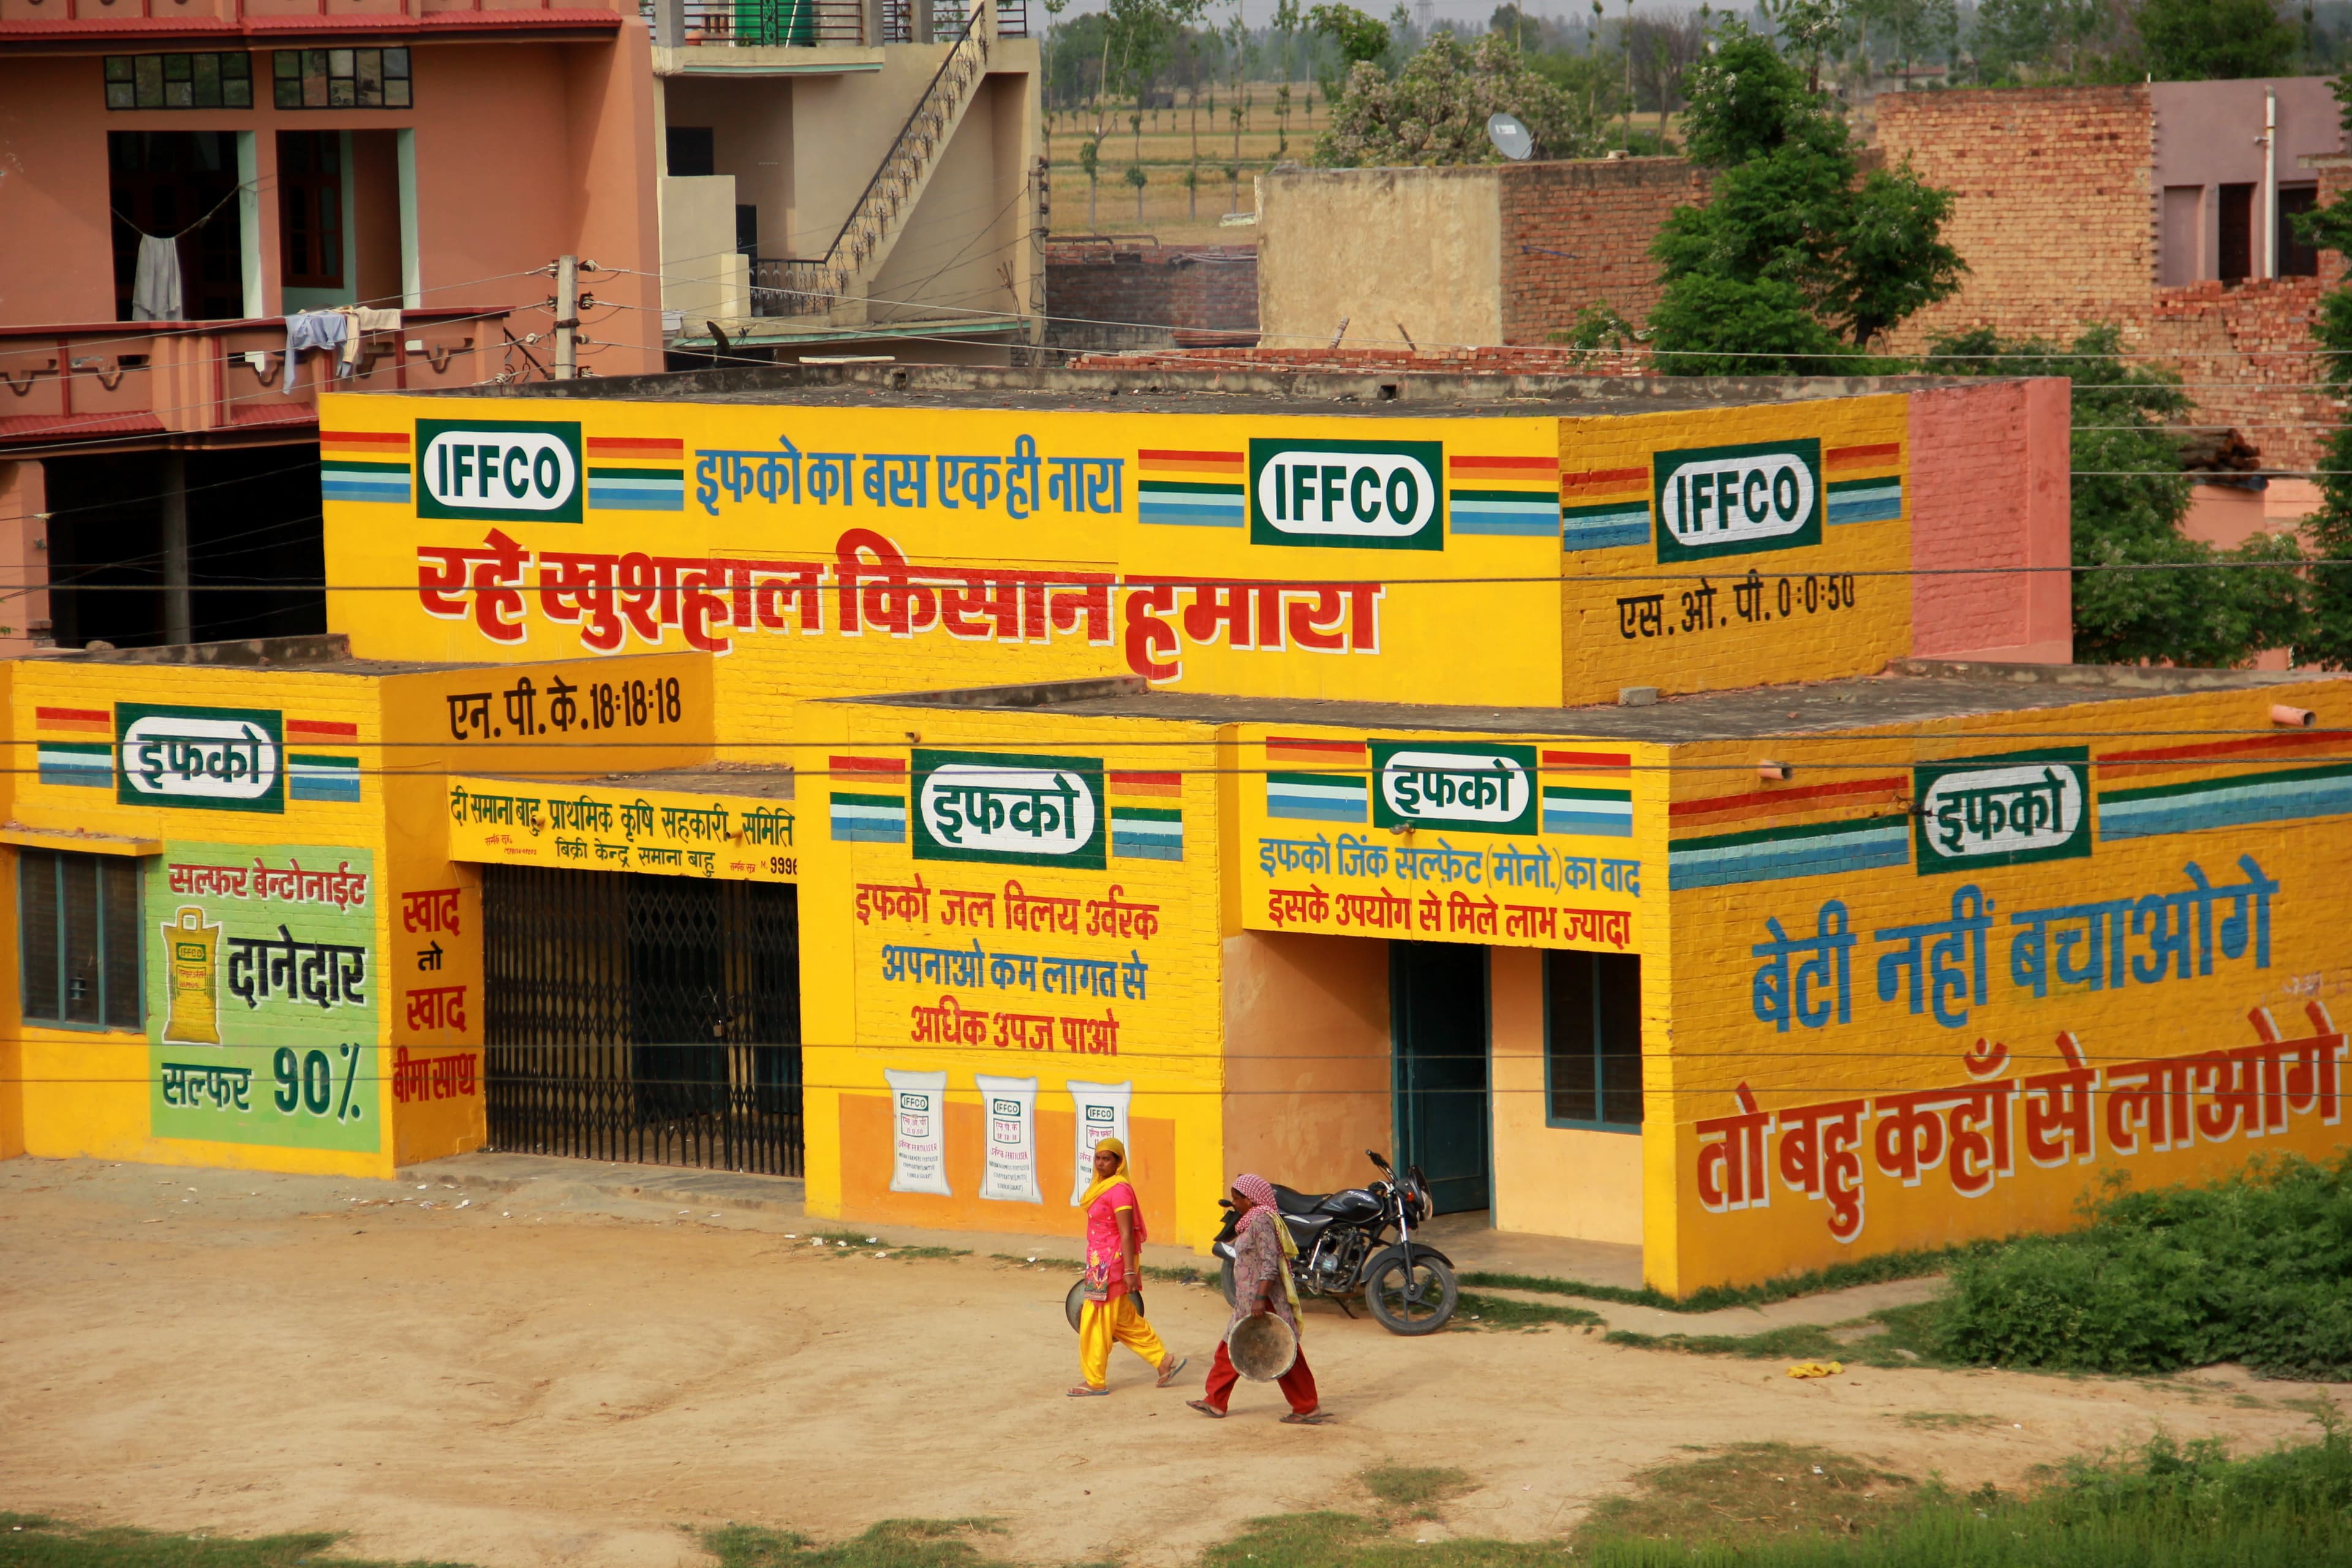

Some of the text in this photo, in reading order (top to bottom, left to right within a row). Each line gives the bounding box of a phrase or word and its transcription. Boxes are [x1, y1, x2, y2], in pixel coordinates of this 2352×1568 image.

[438, 443, 561, 499] IFFCO
[695, 434, 1124, 519] इफको का बस एक ही नारा
[1275, 464, 1418, 525] IFFCO
[1676, 466, 1800, 533] IFFCO
[417, 527, 1386, 685] रहे खुशहाल किसान हमारा
[137, 724, 262, 790] इफको
[1393, 758, 1515, 814] इफको
[450, 785, 468, 826] दी
[470, 794, 513, 825] समाना
[548, 795, 612, 833] प्राथमिक
[620, 798, 654, 842] कृषि
[661, 803, 728, 843] सहकारी
[741, 806, 795, 847] समिति
[933, 772, 1079, 844] इफको
[1936, 768, 2067, 853] इफको
[168, 858, 369, 912] सल्फर बेन्टोनाईट
[555, 837, 715, 878] बिक्री केन्द्र समाना बाहु
[1259, 832, 1330, 878] इफको
[1336, 832, 1389, 878] जिंक
[1565, 856, 1596, 891] का
[1601, 859, 1642, 897] वाद
[856, 873, 1160, 940] इफको जल विलय उर्वरक
[1268, 883, 1631, 951] इसके उपयोग से मिले लाभ ज्यादा
[227, 924, 368, 1009] दानेदार
[417, 941, 443, 971] तो
[881, 938, 1148, 1000] अपनाओ कम लागत से
[1752, 854, 2280, 1033] बेटी नहीं बचाओगे
[911, 995, 1119, 1057] अधिक उपज पाओ
[161, 1062, 252, 1112] सल्फर
[393, 1045, 477, 1102] बीमा साथ
[904, 1097, 925, 1107] IFFCO
[997, 1103, 1018, 1113] IFFCO
[1090, 1109, 1111, 1118] IFFCO
[1696, 1000, 2348, 1244] तो बहु कहाँ से लाओगे
